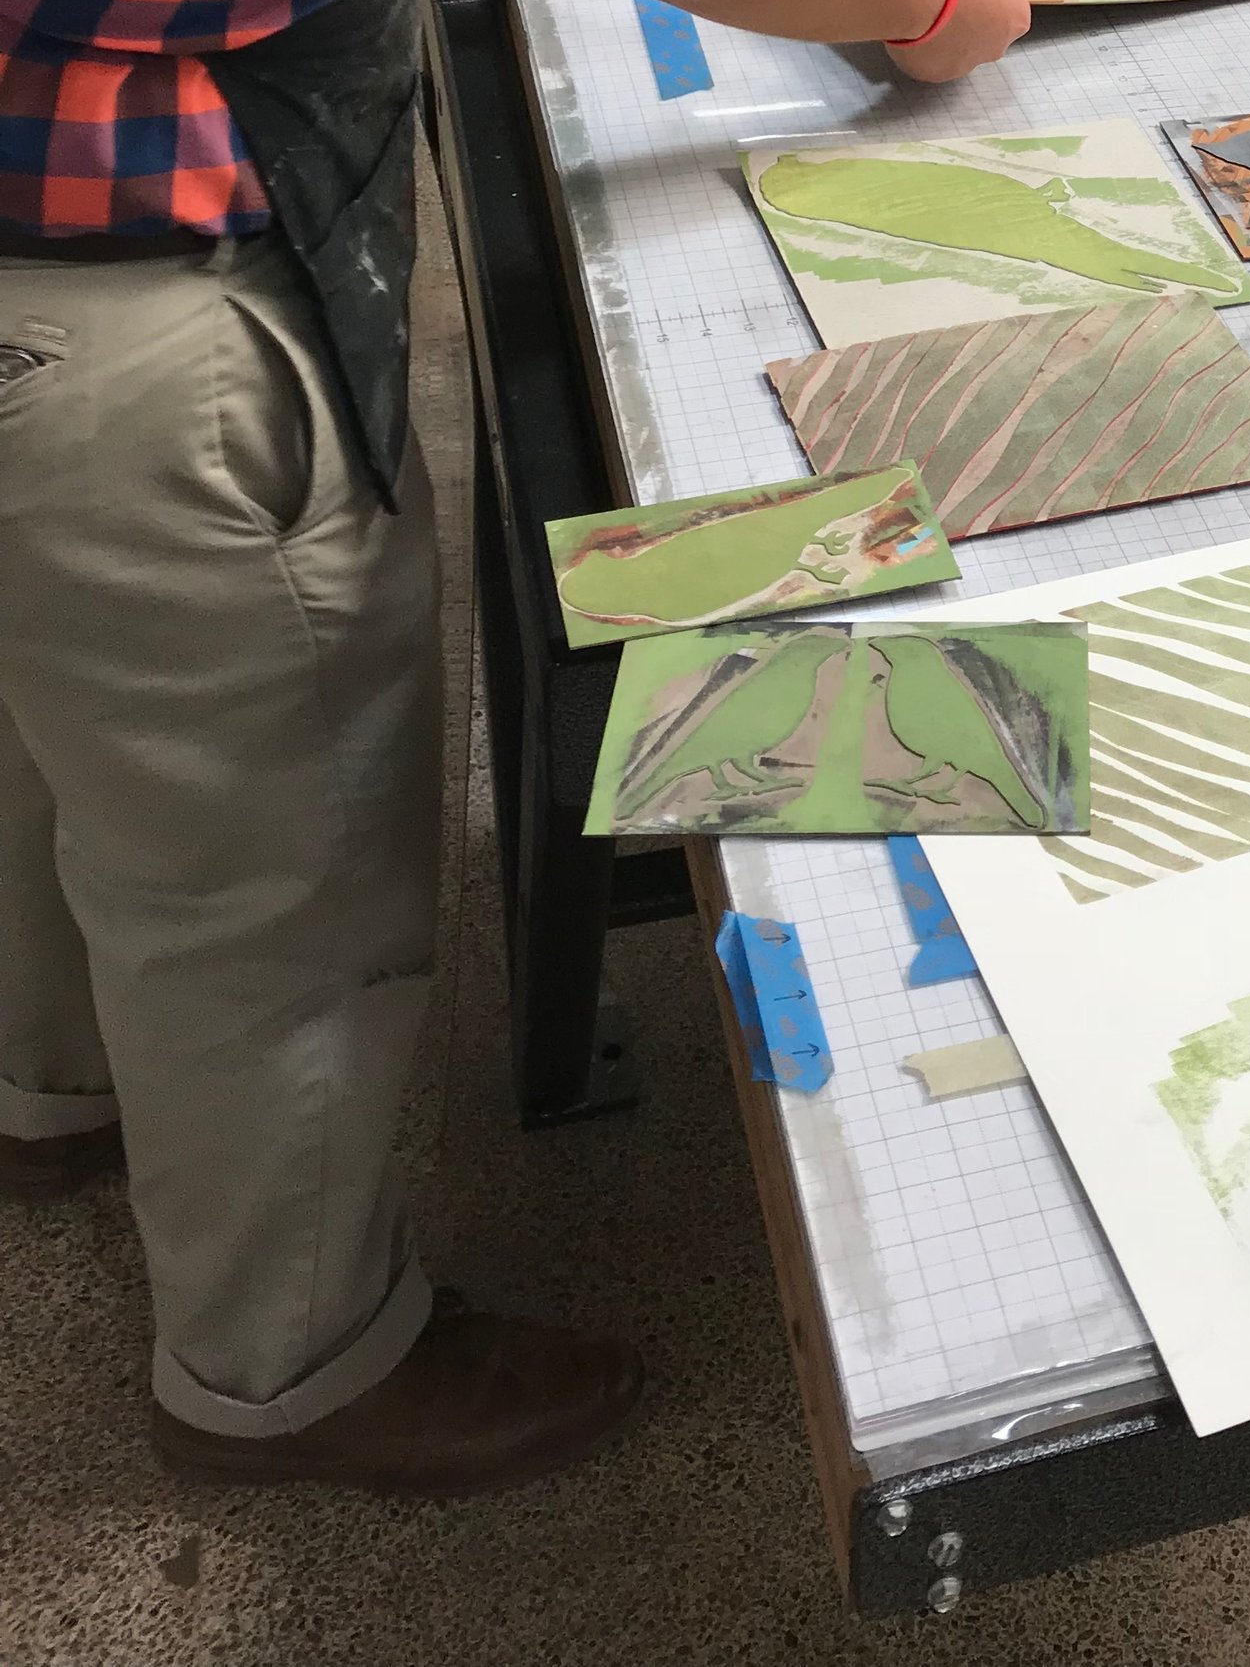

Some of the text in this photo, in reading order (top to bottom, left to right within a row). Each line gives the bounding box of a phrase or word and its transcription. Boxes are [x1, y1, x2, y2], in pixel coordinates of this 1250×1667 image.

[656, 333, 670, 344] 15
[743, 322, 757, 333] 13
[786, 316, 800, 327] 12
